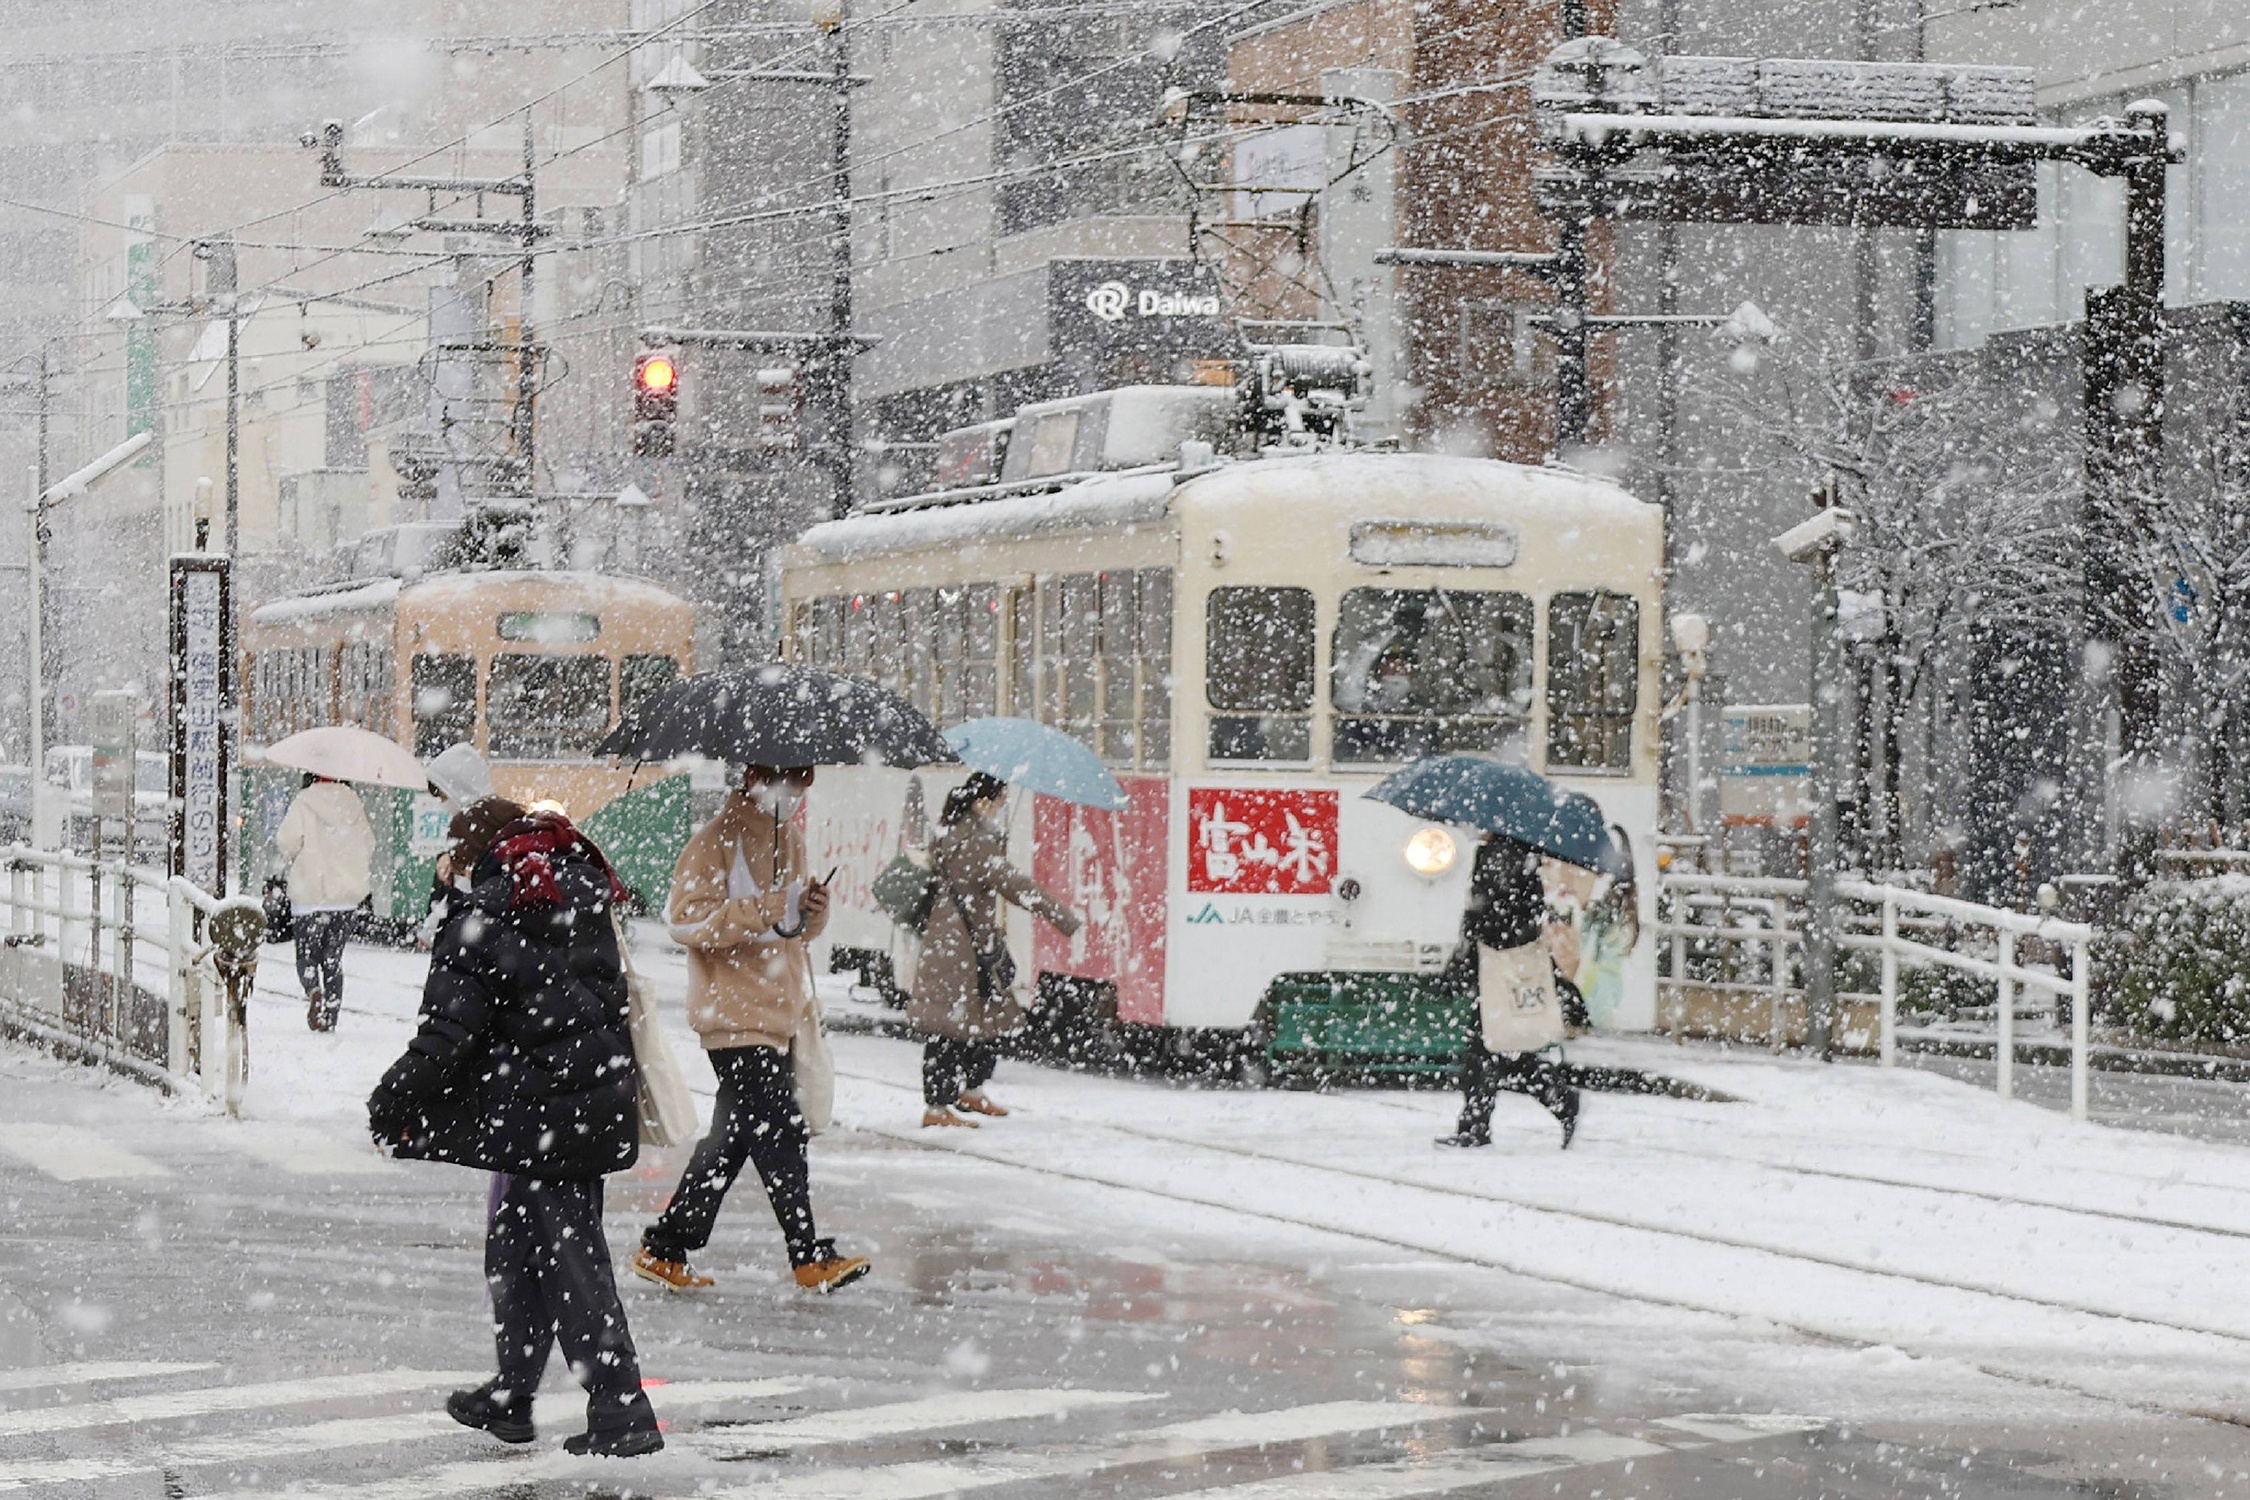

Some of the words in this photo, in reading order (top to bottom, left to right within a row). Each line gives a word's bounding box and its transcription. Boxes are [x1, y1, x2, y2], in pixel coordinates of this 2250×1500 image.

[1138, 290, 1220, 315] Daiwa
[1199, 800, 1330, 883] 富山米
